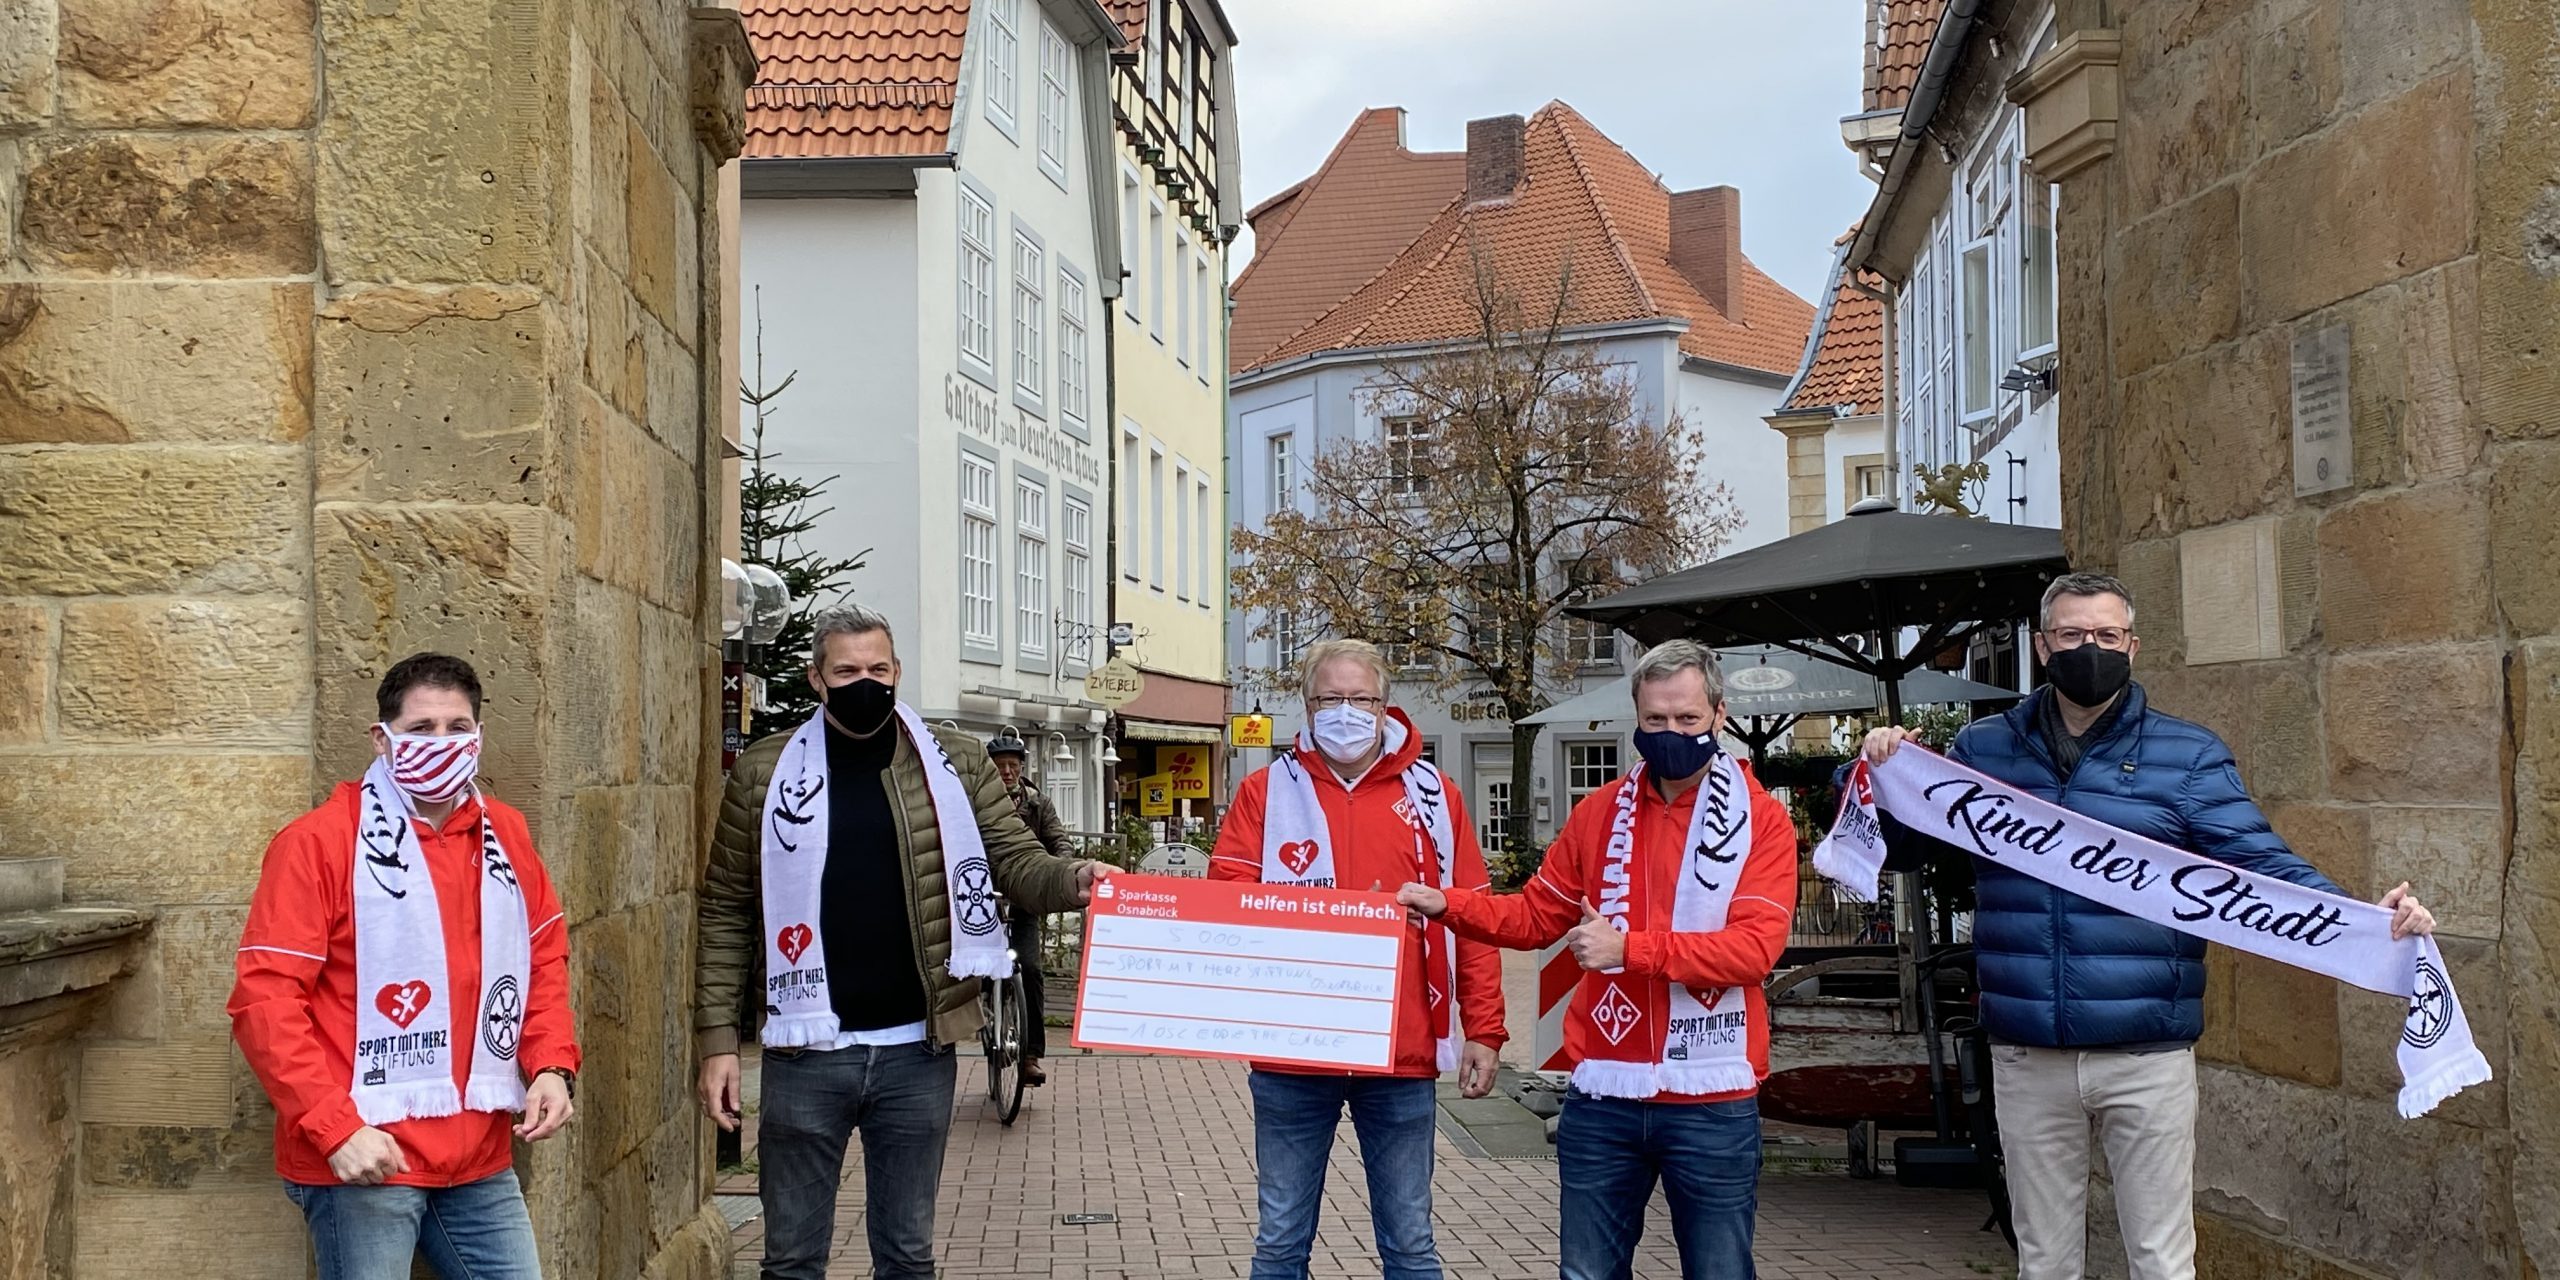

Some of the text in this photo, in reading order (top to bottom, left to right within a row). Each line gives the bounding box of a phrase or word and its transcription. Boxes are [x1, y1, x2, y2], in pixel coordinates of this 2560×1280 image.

[1000, 420, 1017, 446] zum
[1074, 440, 1099, 487] Haus
[1450, 701, 1508, 721] BierCa
[1238, 736, 1266, 745] LOTTO
[1172, 778, 1204, 790] OTTO
[1839, 813, 1875, 849] TIFTUNG
[1923, 779, 2351, 947] Kind der Stadt
[1119, 888, 1178, 904] Sparkasse
[1240, 893, 1401, 921] Helfen ist einfach.
[1117, 903, 1178, 918] Osnabrück
[1118, 953, 1162, 972] SPORT
[1203, 963, 1241, 977] HERZ
[1669, 1010, 1745, 1034] SPORT MIT HERZ
[359, 1029, 447, 1057] SPORT MIT HERZ
[1680, 1029, 1736, 1048] STIFTUNG
[372, 1049, 435, 1071] STIFTUNG
